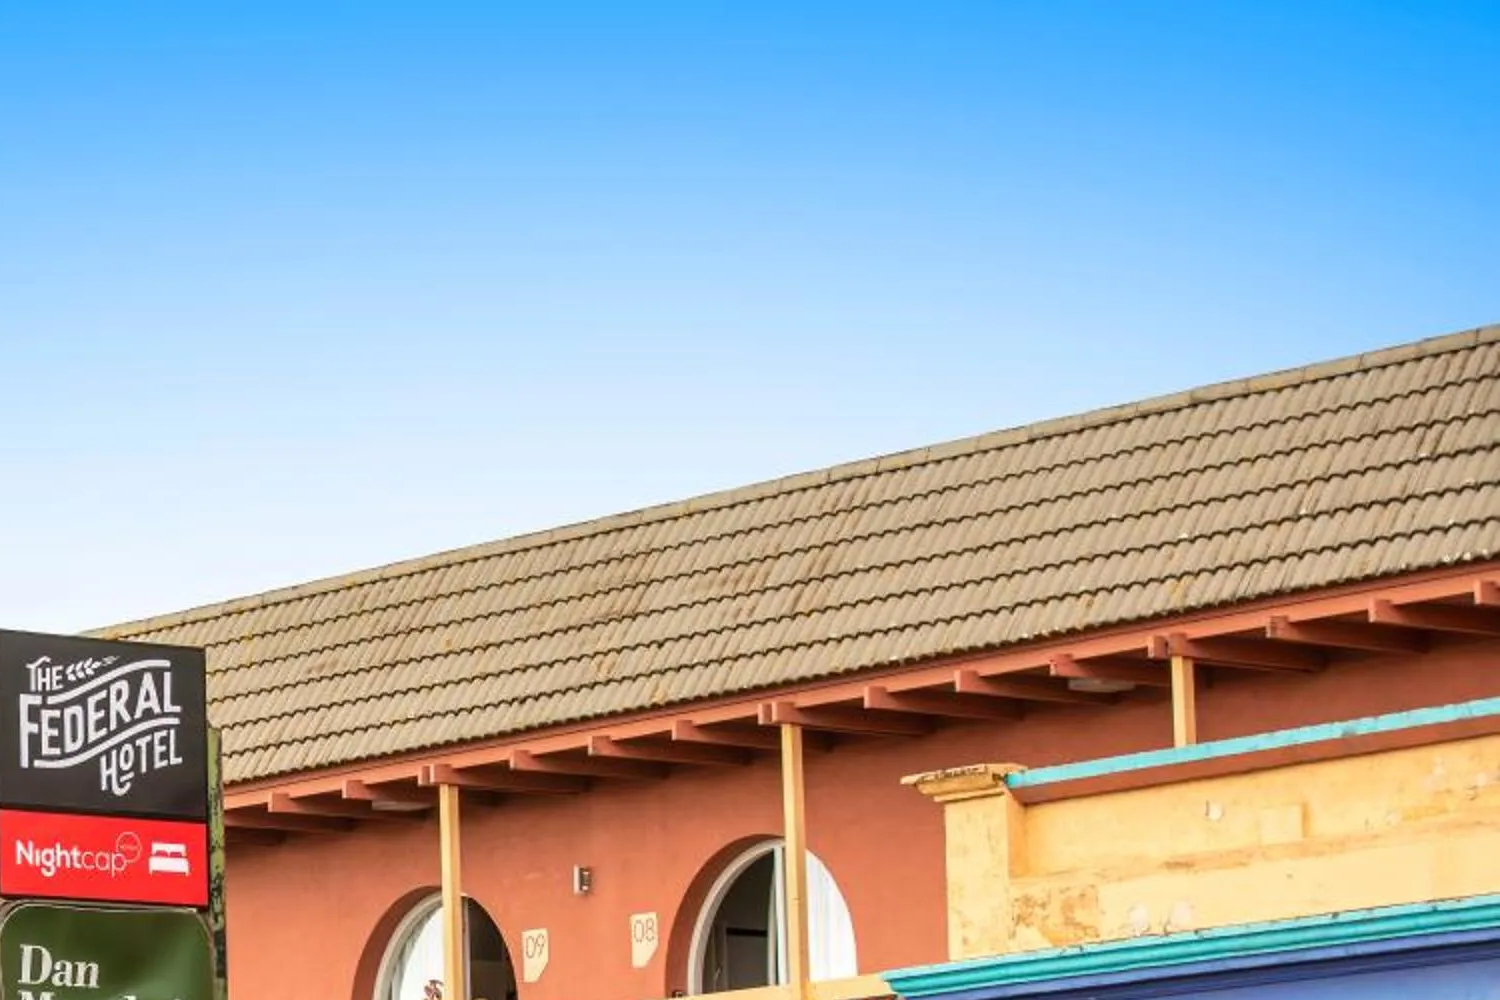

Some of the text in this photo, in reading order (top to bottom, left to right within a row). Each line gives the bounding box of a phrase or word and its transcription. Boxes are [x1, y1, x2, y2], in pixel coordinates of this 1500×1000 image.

[25, 655, 64, 692] THE
[19, 671, 182, 768] FEDERAL
[100, 727, 183, 797] HOTEL
[15, 839, 127, 878] Nightcap
[525, 933, 545, 959] 09
[633, 917, 655, 943] 08
[17, 943, 100, 988] Dan
